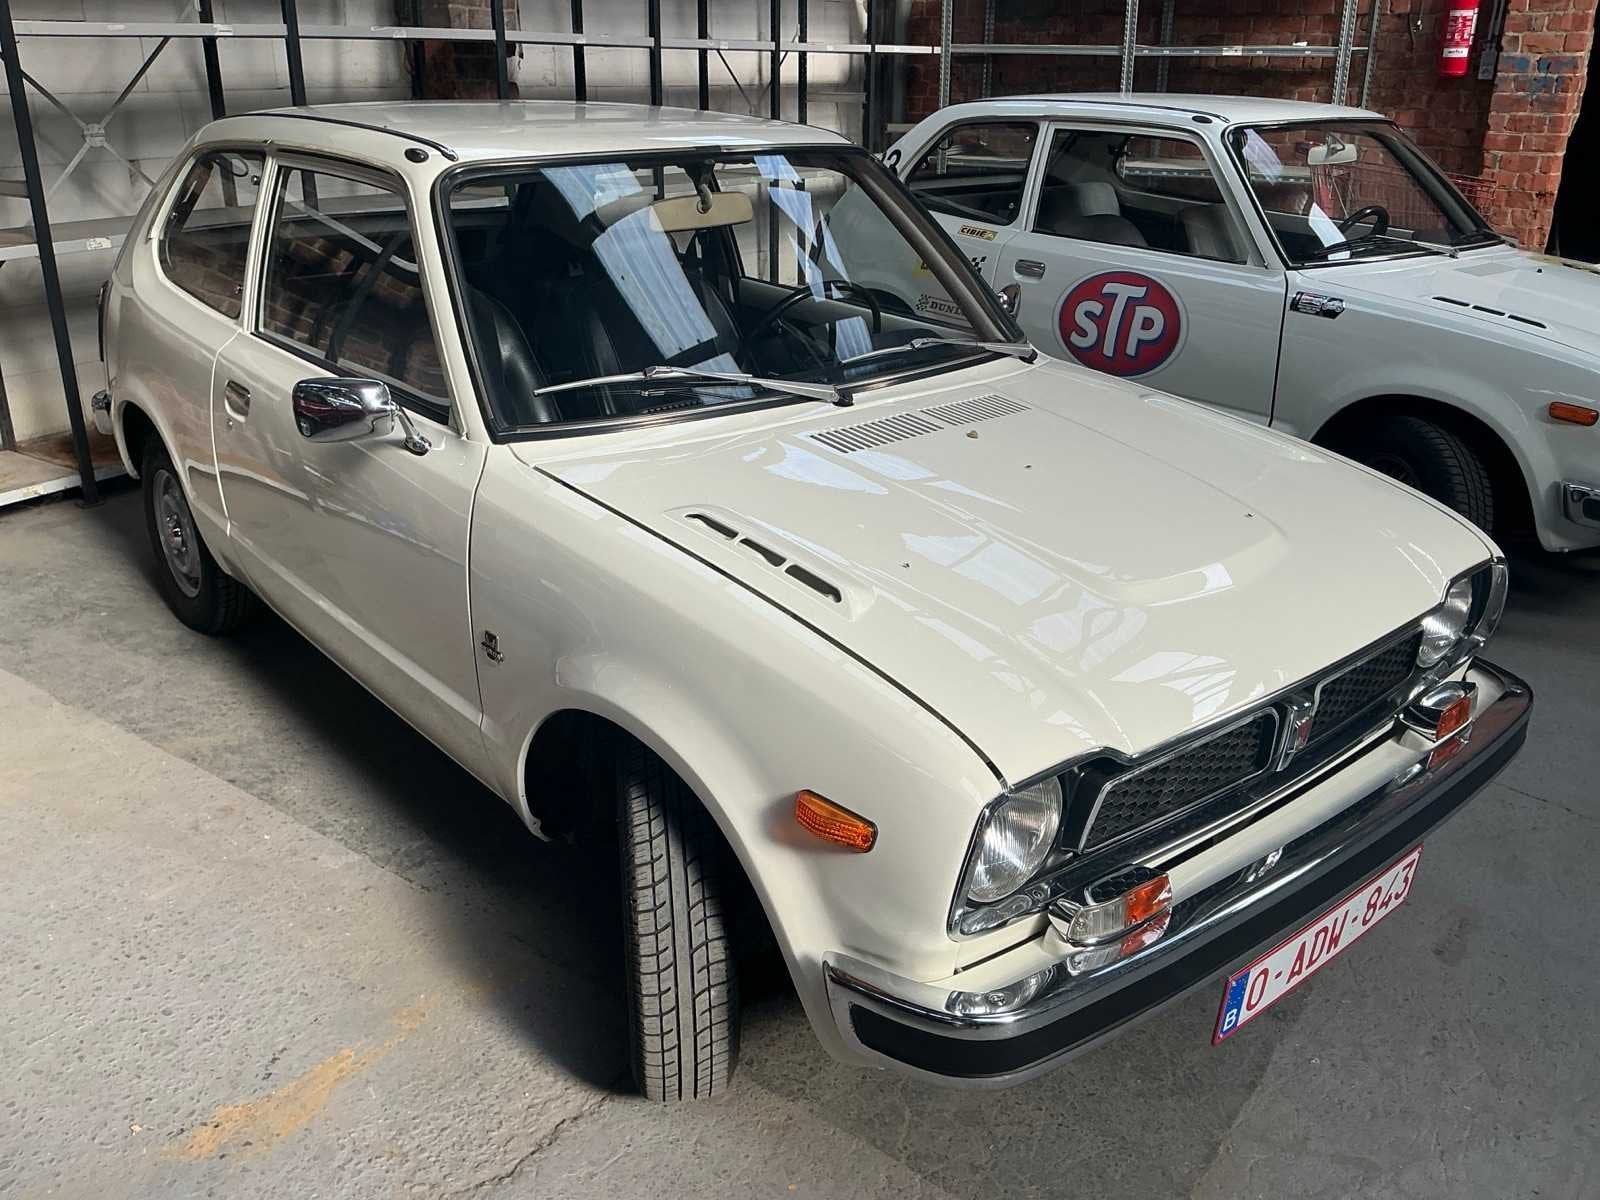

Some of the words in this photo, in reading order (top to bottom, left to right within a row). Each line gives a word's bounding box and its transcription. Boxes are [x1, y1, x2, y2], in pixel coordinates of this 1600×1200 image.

[929, 301, 962, 315] DUNL
[1069, 282, 1165, 358] STP
[1222, 1008, 1238, 1032] B
